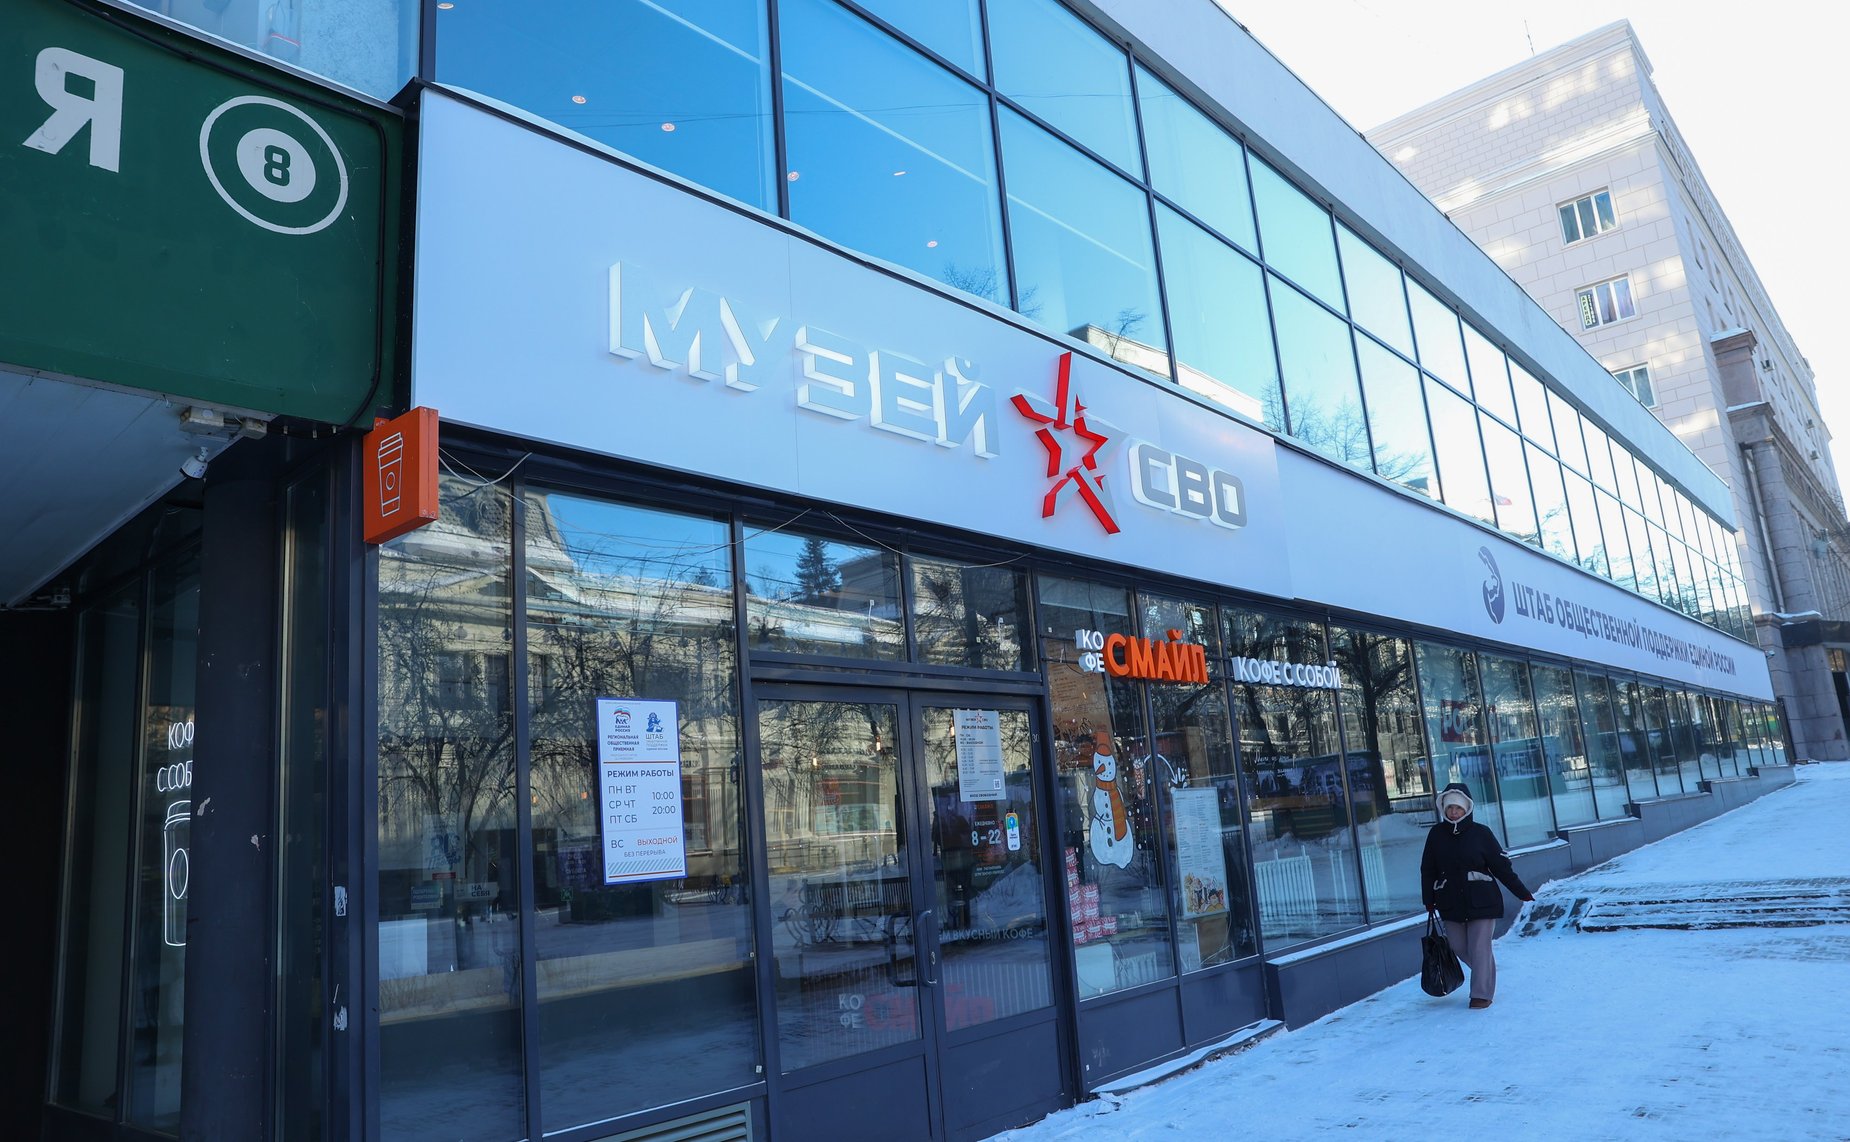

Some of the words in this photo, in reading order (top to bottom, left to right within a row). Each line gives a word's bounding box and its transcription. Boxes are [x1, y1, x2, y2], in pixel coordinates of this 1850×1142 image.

[22, 47, 124, 173] Я
[263, 145, 291, 187] 8
[1581, 296, 1591, 325] АРЕНДА
[609, 260, 998, 459] МУЗЕЙ
[1129, 439, 1247, 529] СВО
[1511, 581, 1554, 625] ШТАБ
[1555, 596, 1643, 649] ОБЩЕСТВЕННОЙ
[1642, 627, 1689, 663] ПОДДЕРЖКИ
[1688, 640, 1715, 670] ЕДИНОЙ
[1714, 651, 1737, 676] РОССИИ
[1075, 629, 1105, 650] КО
[1104, 629, 1209, 684] СМАЙЛ
[1079, 652, 1106, 673] ФЕ
[1231, 656, 1281, 683] КОФЕ
[1283, 663, 1295, 685] С
[1294, 660, 1342, 689] СОБОЙ
[168, 719, 195, 750] КОФ
[167, 760, 193, 790] СОБ
[607, 769, 639, 778] РЕЖИМ
[641, 769, 675, 777] РАБОТЫ
[608, 785, 623, 794] ПН
[625, 784, 637, 794] ВТ
[652, 791, 675, 800] 10:00
[608, 800, 622, 809] СР
[623, 800, 636, 808] ЧТ
[652, 806, 676, 815] 20:00
[609, 815, 622, 824] ПТ
[624, 814, 638, 823] СБ
[611, 839, 624, 848] ВС
[637, 835, 678, 846] ВЫХОДНОЙ
[635, 849, 666, 857] ПЕРЕРЫВА
[1003, 927, 1033, 939] КОФЕ
